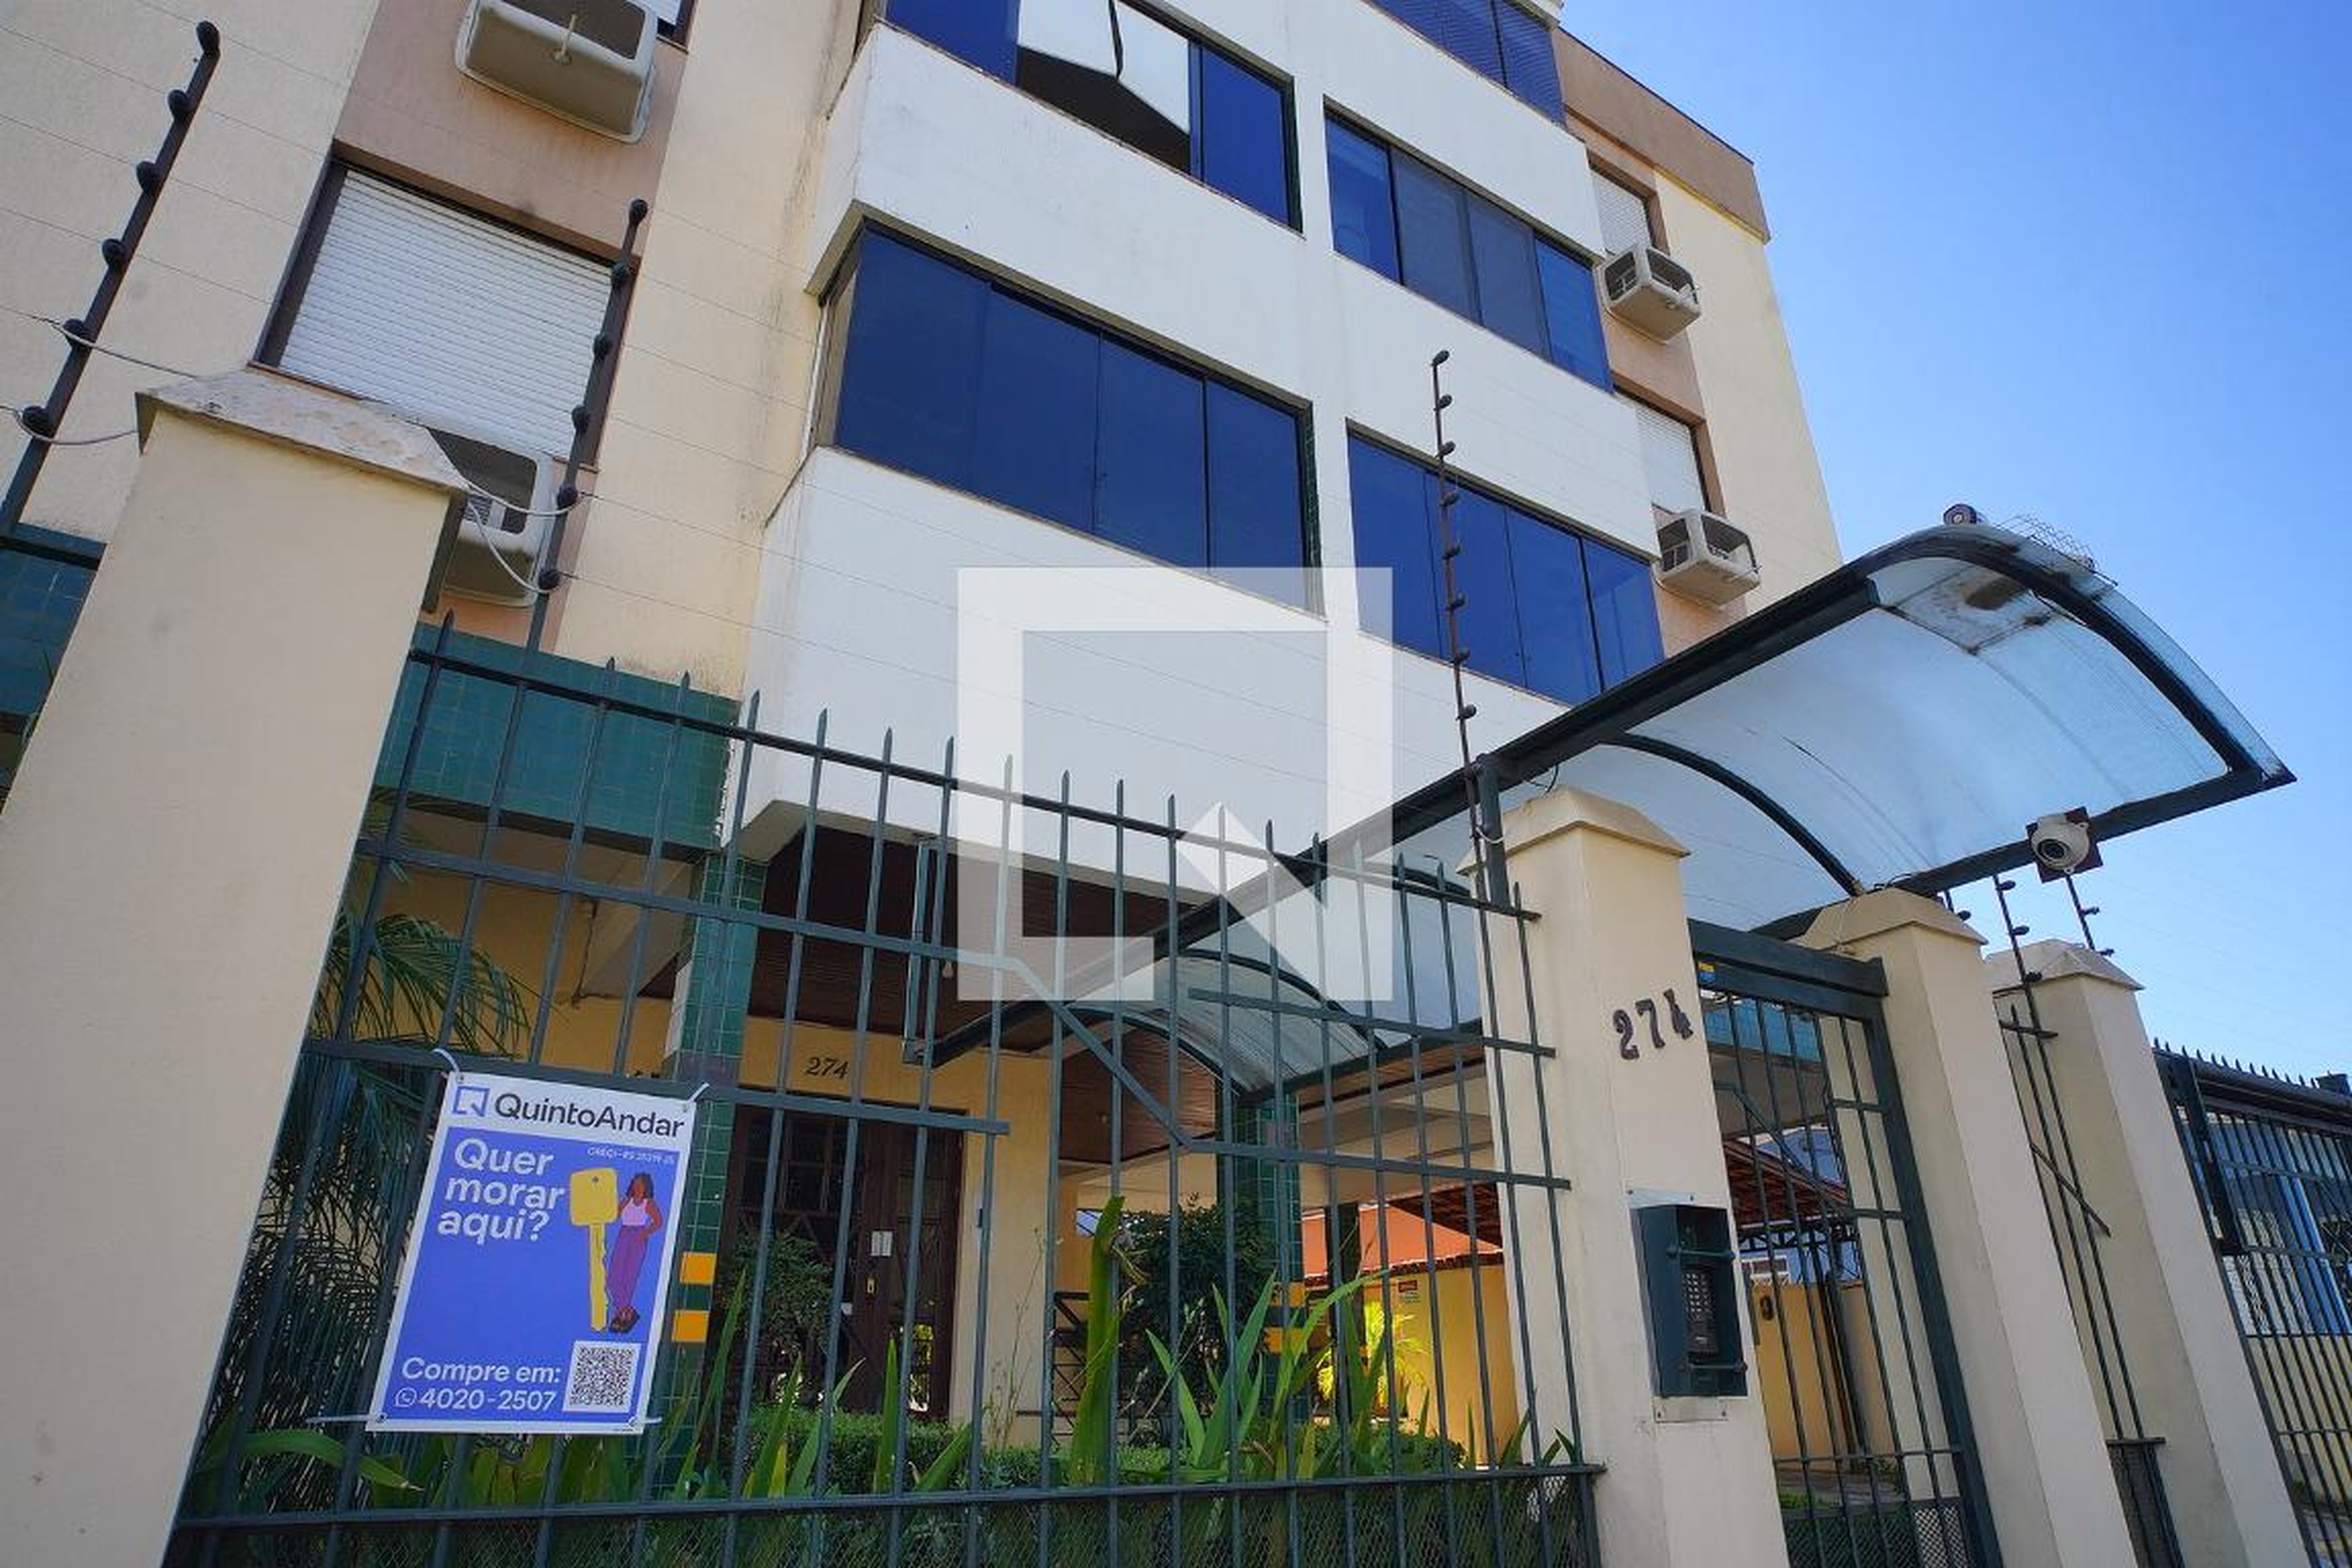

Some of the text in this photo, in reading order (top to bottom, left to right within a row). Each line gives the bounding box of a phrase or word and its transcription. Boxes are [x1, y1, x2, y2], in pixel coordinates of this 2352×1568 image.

[1613, 988, 1694, 1060] 274
[804, 1056, 848, 1079] 274
[494, 1093, 685, 1138] QuintoAndar
[454, 1137, 554, 1175] Quer
[445, 1177, 565, 1210] morar
[438, 1208, 550, 1245] aqui?
[402, 1357, 561, 1386] Compre em:
[418, 1388, 556, 1411] 4020-2507
